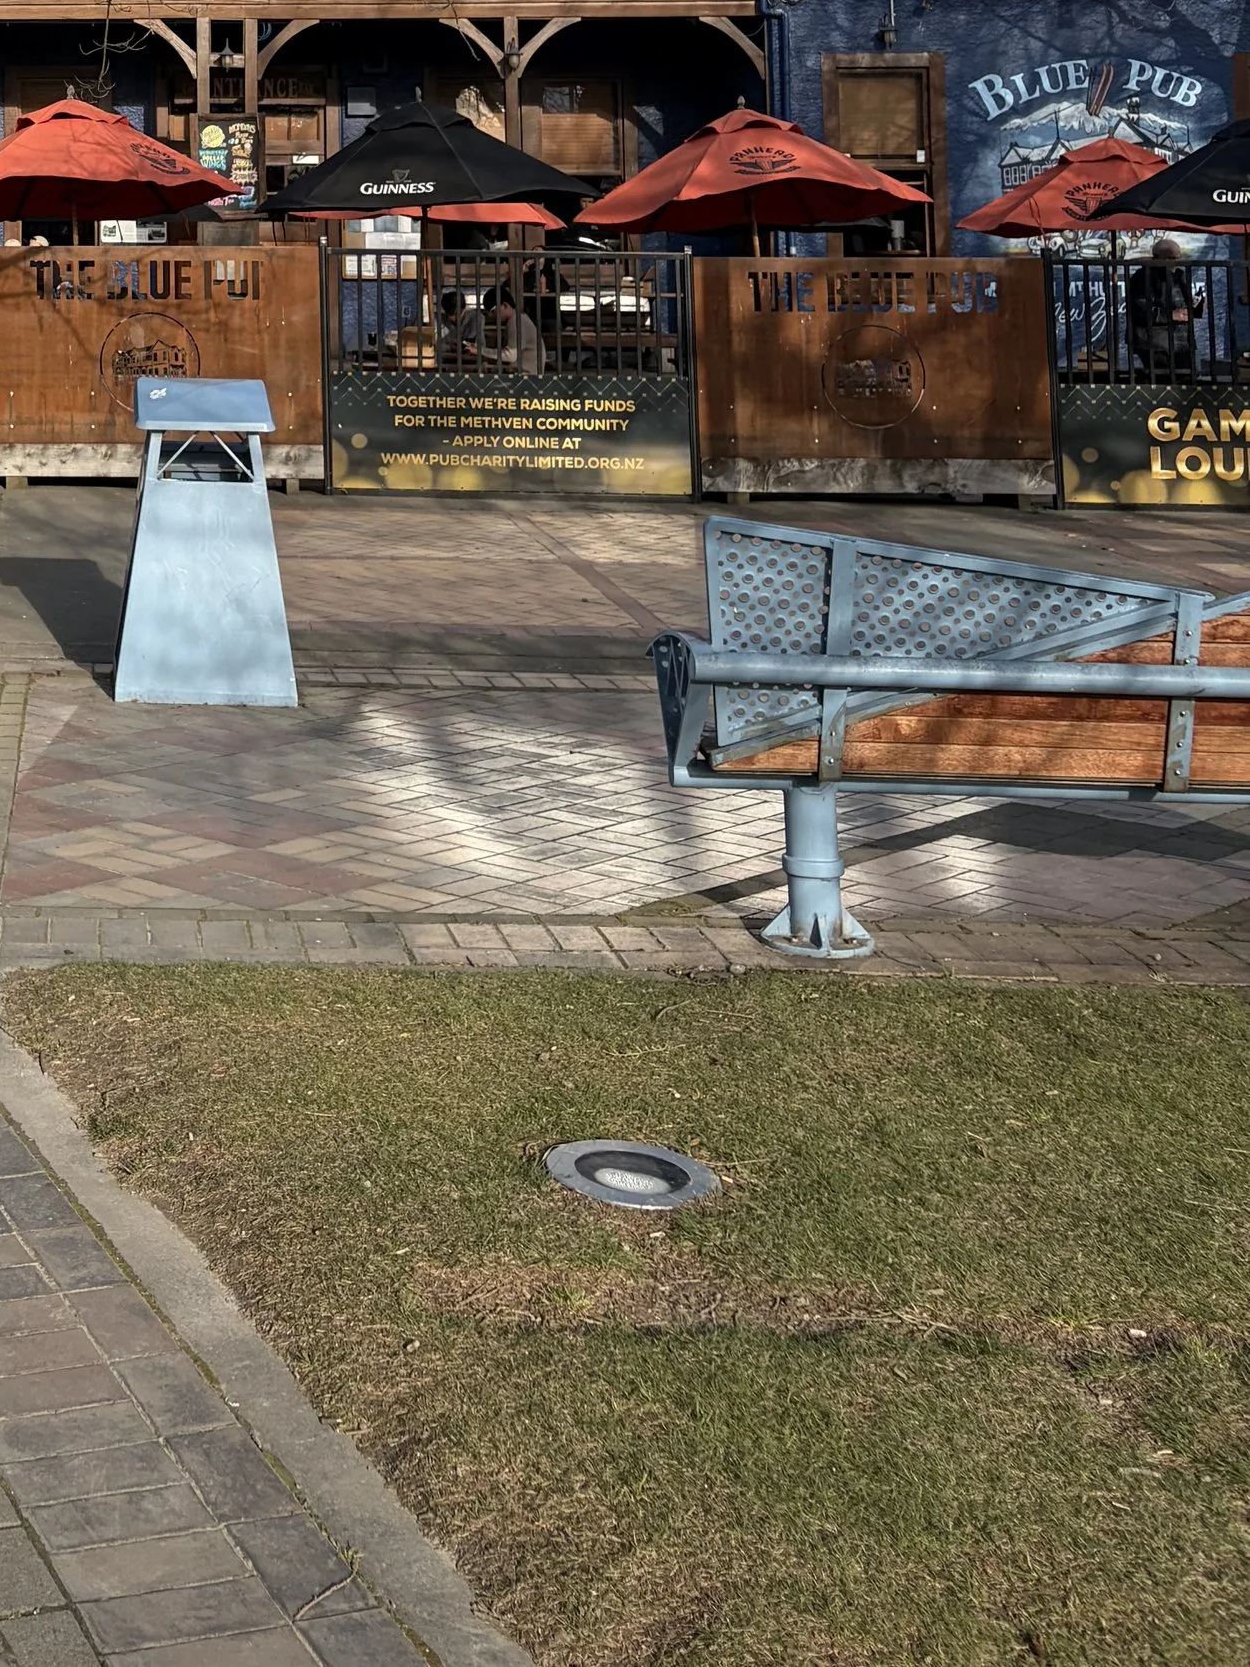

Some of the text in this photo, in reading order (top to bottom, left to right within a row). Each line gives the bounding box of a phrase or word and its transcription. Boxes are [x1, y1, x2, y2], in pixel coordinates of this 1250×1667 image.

[209, 77, 299, 98] NTNCE
[968, 58, 1203, 121] BLUE PUB
[729, 146, 795, 162] PANHEAD
[359, 182, 435, 195] GUINNESS
[1065, 182, 1120, 197] PANHEA
[30, 260, 95, 300] THE
[107, 260, 192, 300] BLUE
[748, 272, 998, 313] THE BLUE PUB
[387, 395, 636, 413] TOGETHER WE'RE RAISING FUNDS
[394, 415, 629, 432] FOR THE METHVEN COMMUNITY
[452, 435, 500, 448] APPLY
[502, 436, 559, 449] ONLINE
[562, 437, 582, 450] AT
[380, 452, 645, 470] WWW.PUBCHARITYLIMITED.ORG.NZ
[1150, 446, 1250, 481] LOU
